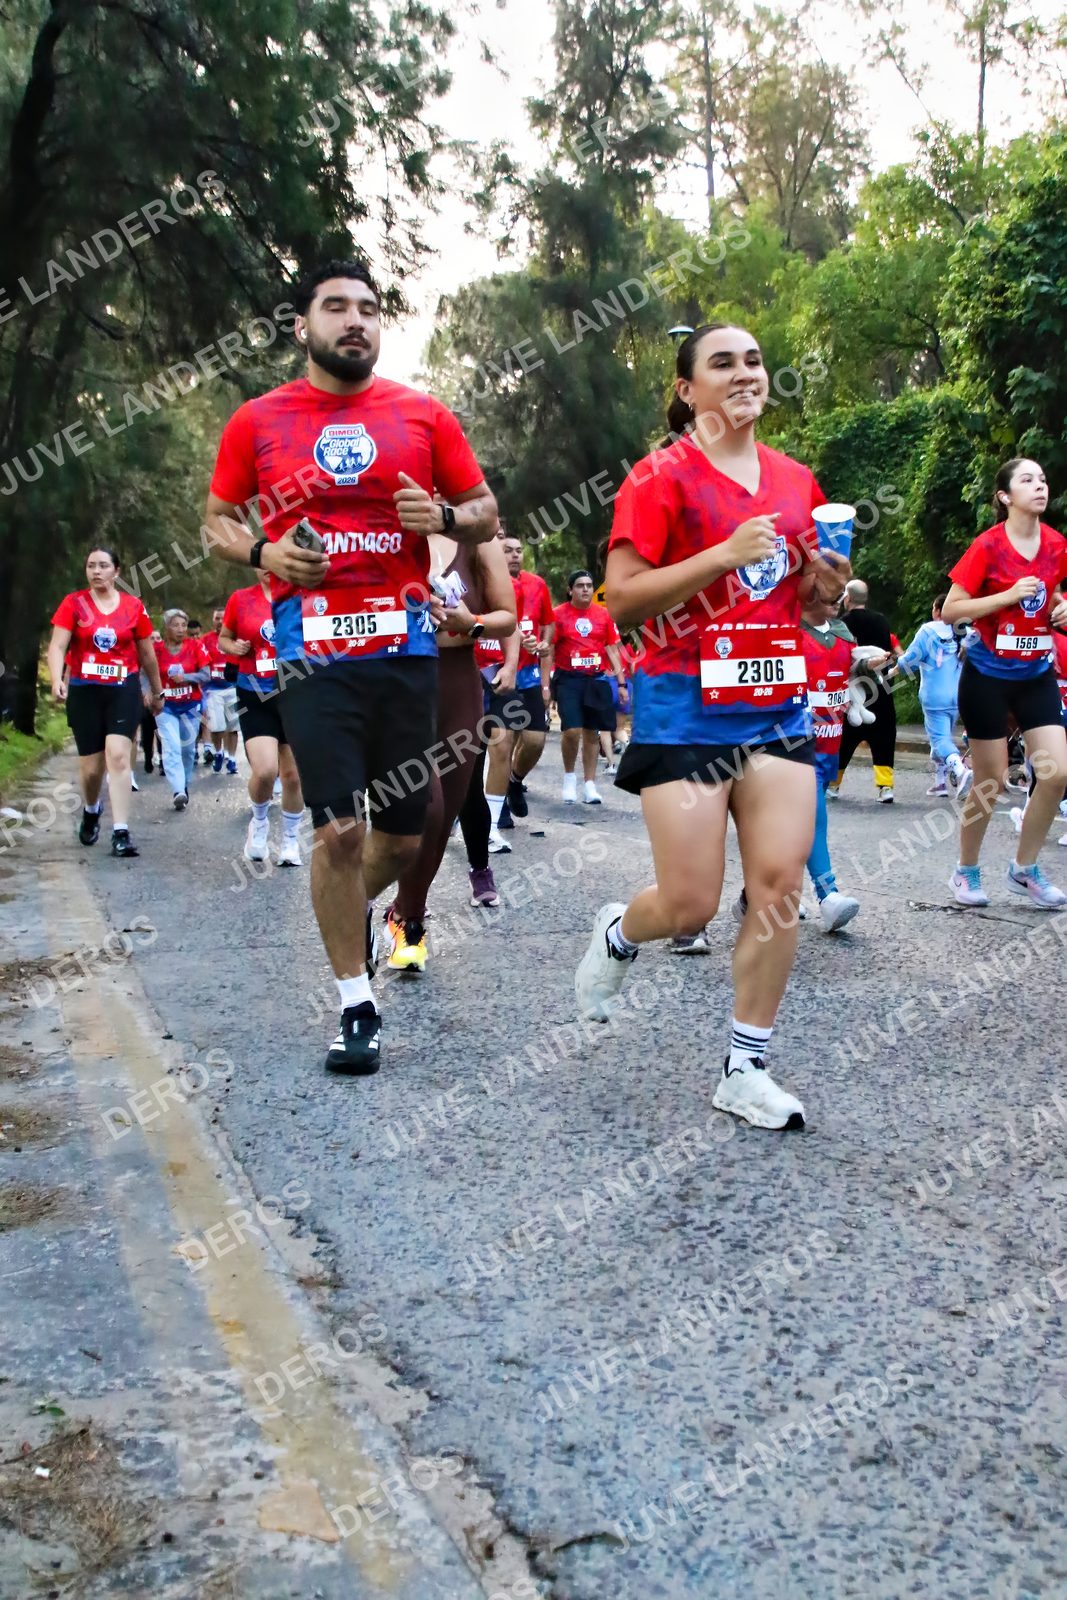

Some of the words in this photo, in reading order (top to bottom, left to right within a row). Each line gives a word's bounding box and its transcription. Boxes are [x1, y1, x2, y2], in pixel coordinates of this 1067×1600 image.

[329, 438, 360, 448] Global
[323, 447, 349, 456] Race
[322, 532, 402, 555] ANTIAGO
[332, 615, 377, 637] 2305
[1015, 637, 1038, 649] 1569
[96, 665, 115, 675] 1648
[737, 659, 784, 684] 2306
